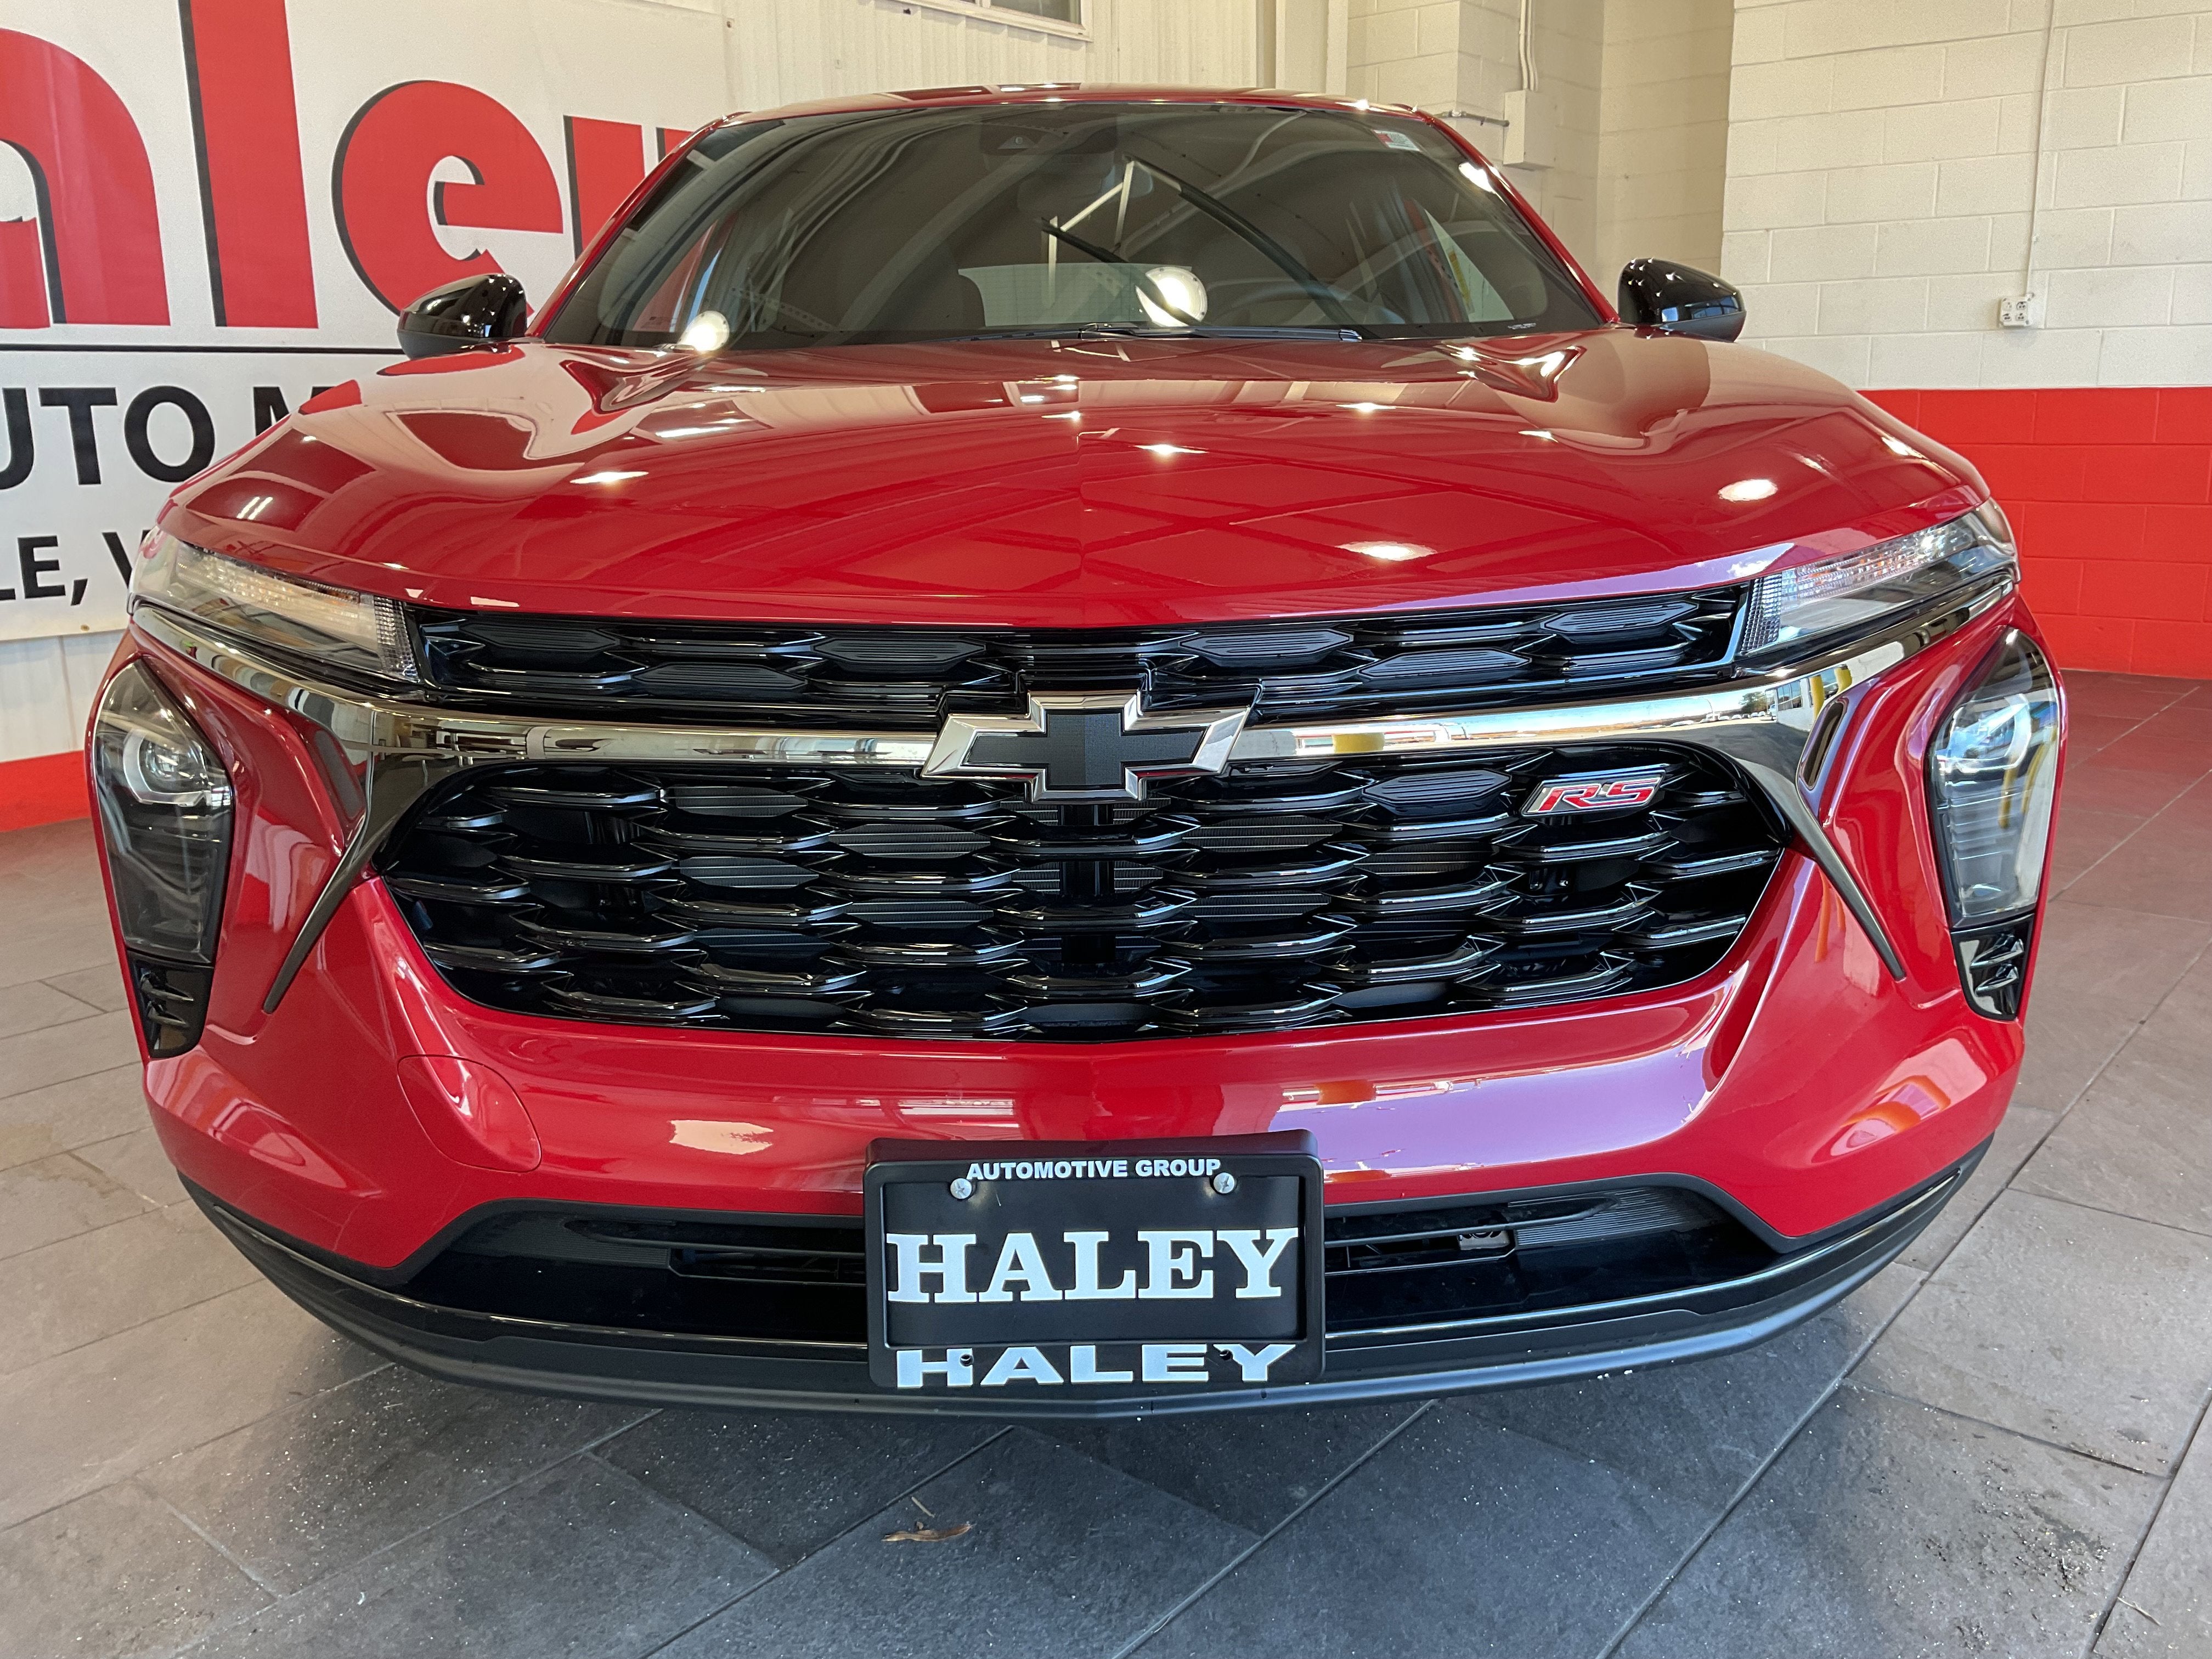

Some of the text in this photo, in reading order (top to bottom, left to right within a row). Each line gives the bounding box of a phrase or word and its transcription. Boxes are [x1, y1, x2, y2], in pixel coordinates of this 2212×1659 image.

[1536, 777, 1660, 812] RS
[966, 1159, 1221, 1181] AUTOMOTIVE GROUP
[886, 1227, 1299, 1304] HALEY
[896, 1344, 1296, 1389] HALEY
